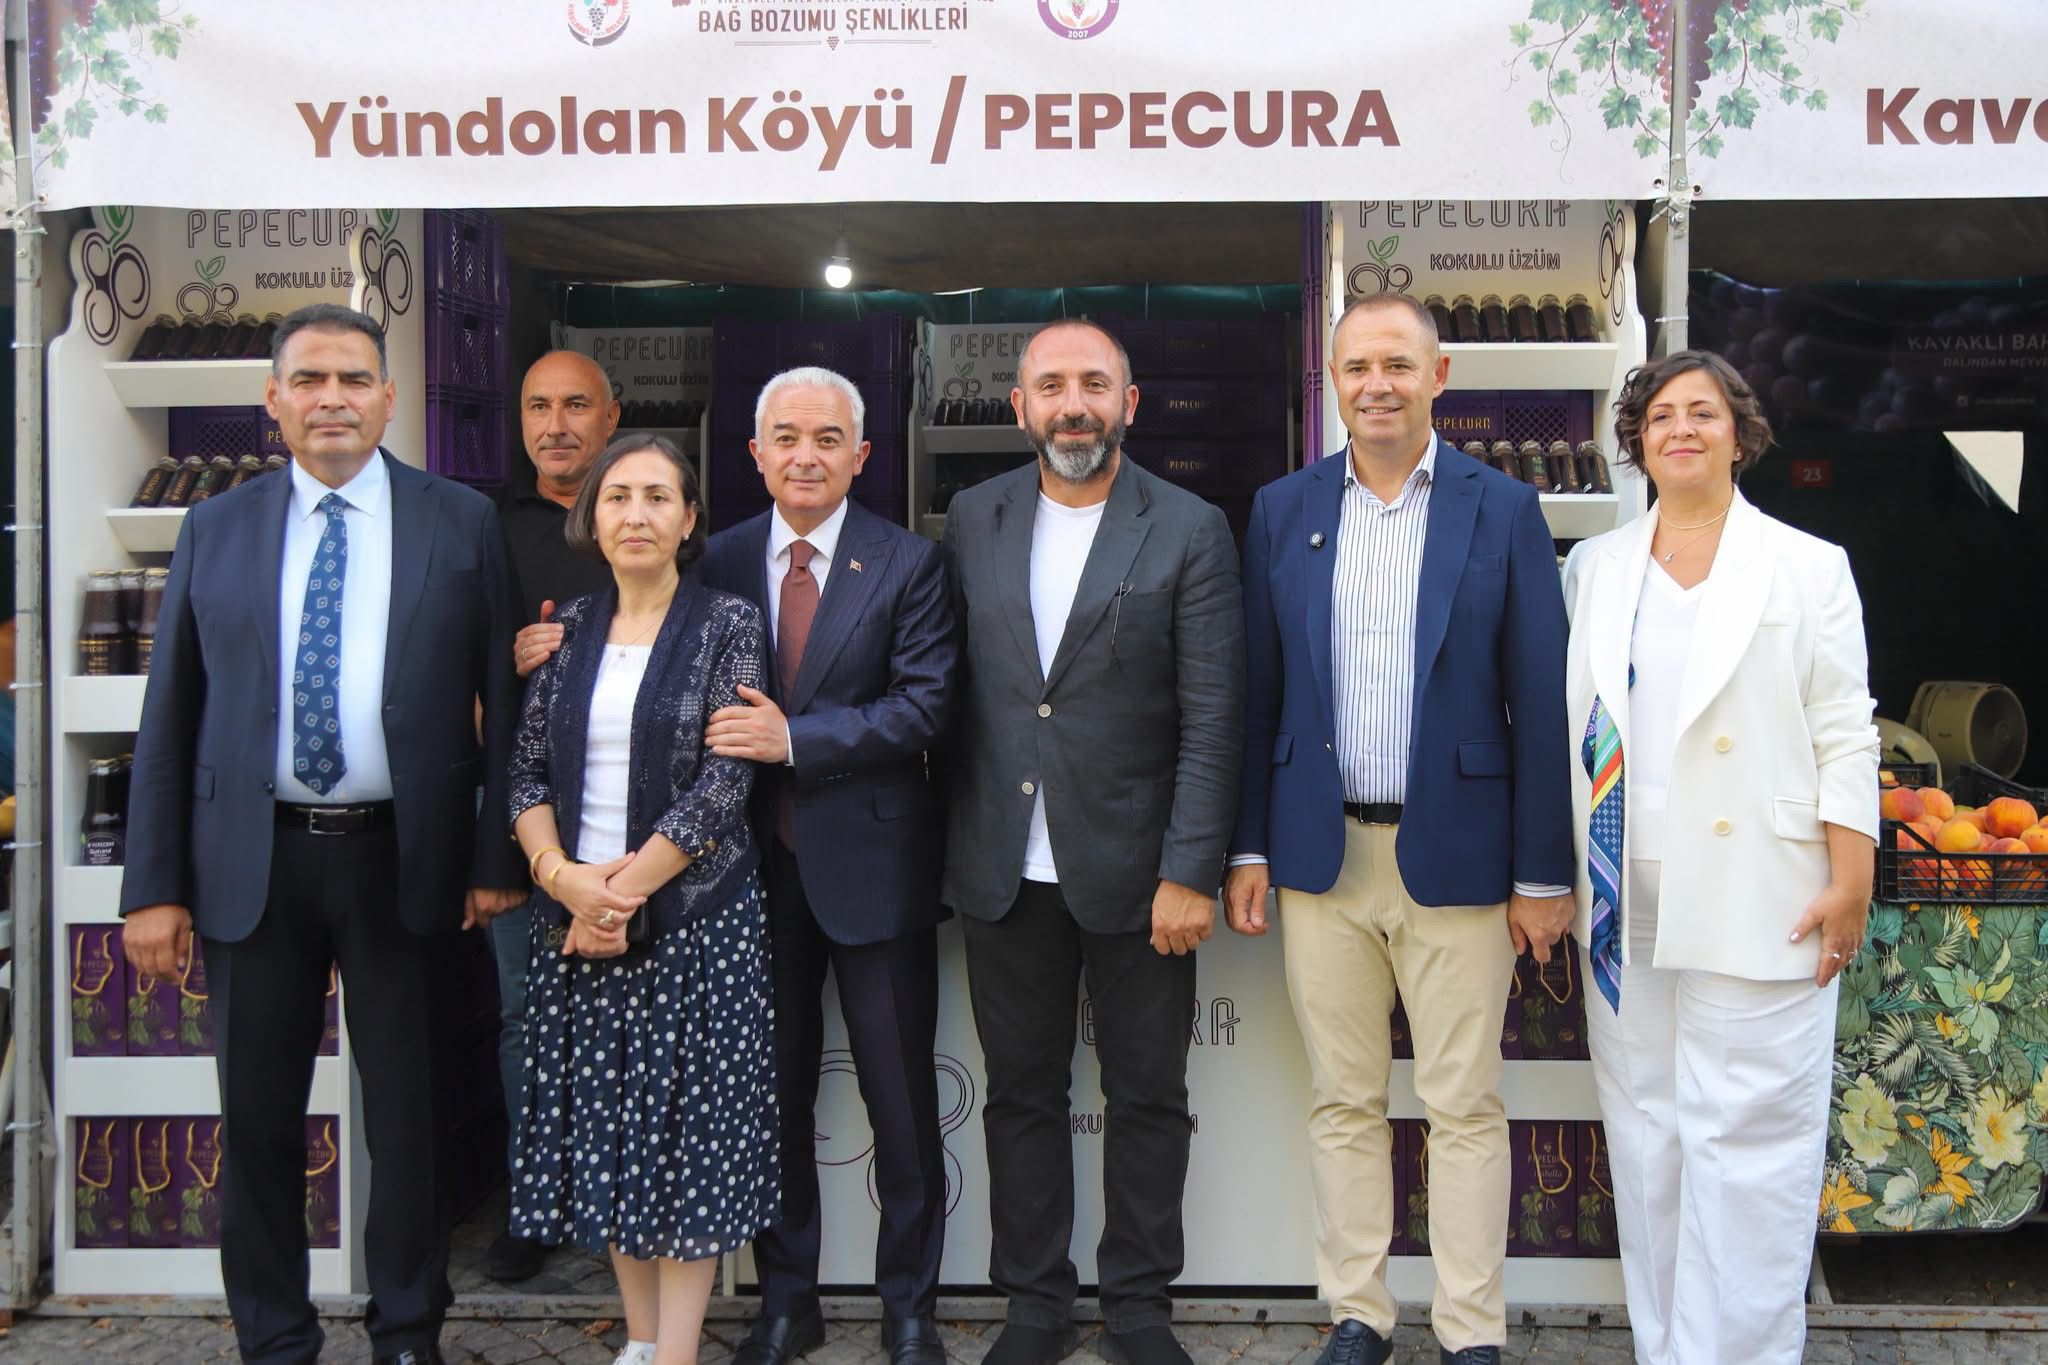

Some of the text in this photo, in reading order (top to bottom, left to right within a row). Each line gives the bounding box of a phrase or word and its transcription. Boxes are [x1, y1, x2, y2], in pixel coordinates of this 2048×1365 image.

[698, 2, 968, 34] BAĞ BOZUMU ŞENLİKLERİ
[1067, 30, 1089, 39] 2007
[294, 75, 1401, 172] Yündolan Köyü / PEPECURA
[187, 208, 360, 249] PEPECUR
[1430, 248, 1561, 271] KOKULU ÜZÜM
[255, 267, 353, 289] KOKULU ÜZ
[950, 332, 1033, 358] PEPEC
[1907, 336, 2004, 351] KAVAKLI
[1803, 467, 1821, 482] 23
